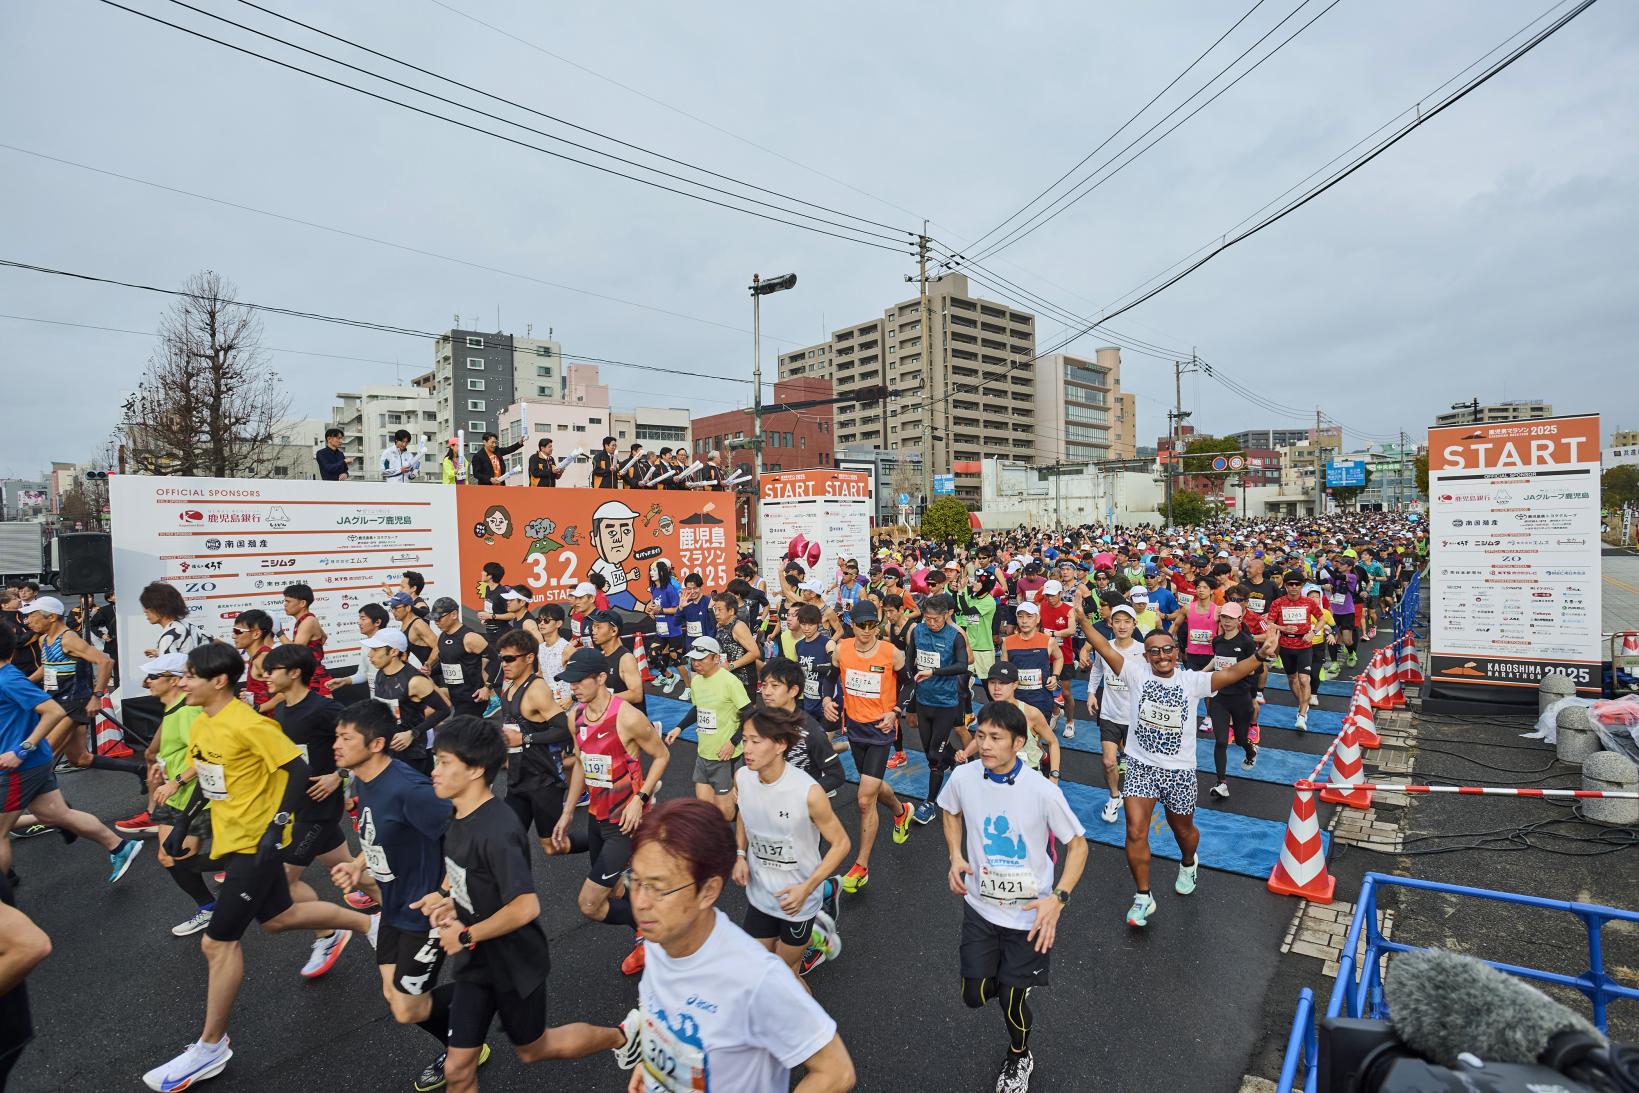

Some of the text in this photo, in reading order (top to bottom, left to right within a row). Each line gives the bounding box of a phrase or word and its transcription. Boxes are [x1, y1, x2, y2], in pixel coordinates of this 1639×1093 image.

[1531, 425, 1557, 435] 2025
[1443, 437, 1586, 470] START
[156, 488, 260, 497] OFFICIAL SPONSORS
[765, 481, 815, 499] START
[825, 481, 864, 497] START
[1523, 492, 1589, 501] JAグループ鹿児島
[208, 513, 260, 523] 鹿児島銀行
[336, 516, 412, 525] JAグループ鹿児島
[225, 539, 268, 548] 南国殖産
[680, 527, 725, 549] 鹿児島
[261, 558, 296, 568] ニシムタ
[680, 550, 725, 565] マラソン
[527, 551, 578, 588] 3.2
[680, 565, 727, 589] 225
[186, 582, 216, 592] ZO
[546, 589, 570, 601] STA
[920, 655, 935, 664] 1352
[1487, 663, 1542, 675] KAGOSHIMA
[1487, 670, 1542, 680] MARATHON
[1140, 708, 1171, 721] A 339
[756, 842, 783, 856] 1137
[980, 879, 1023, 892] A 1421
